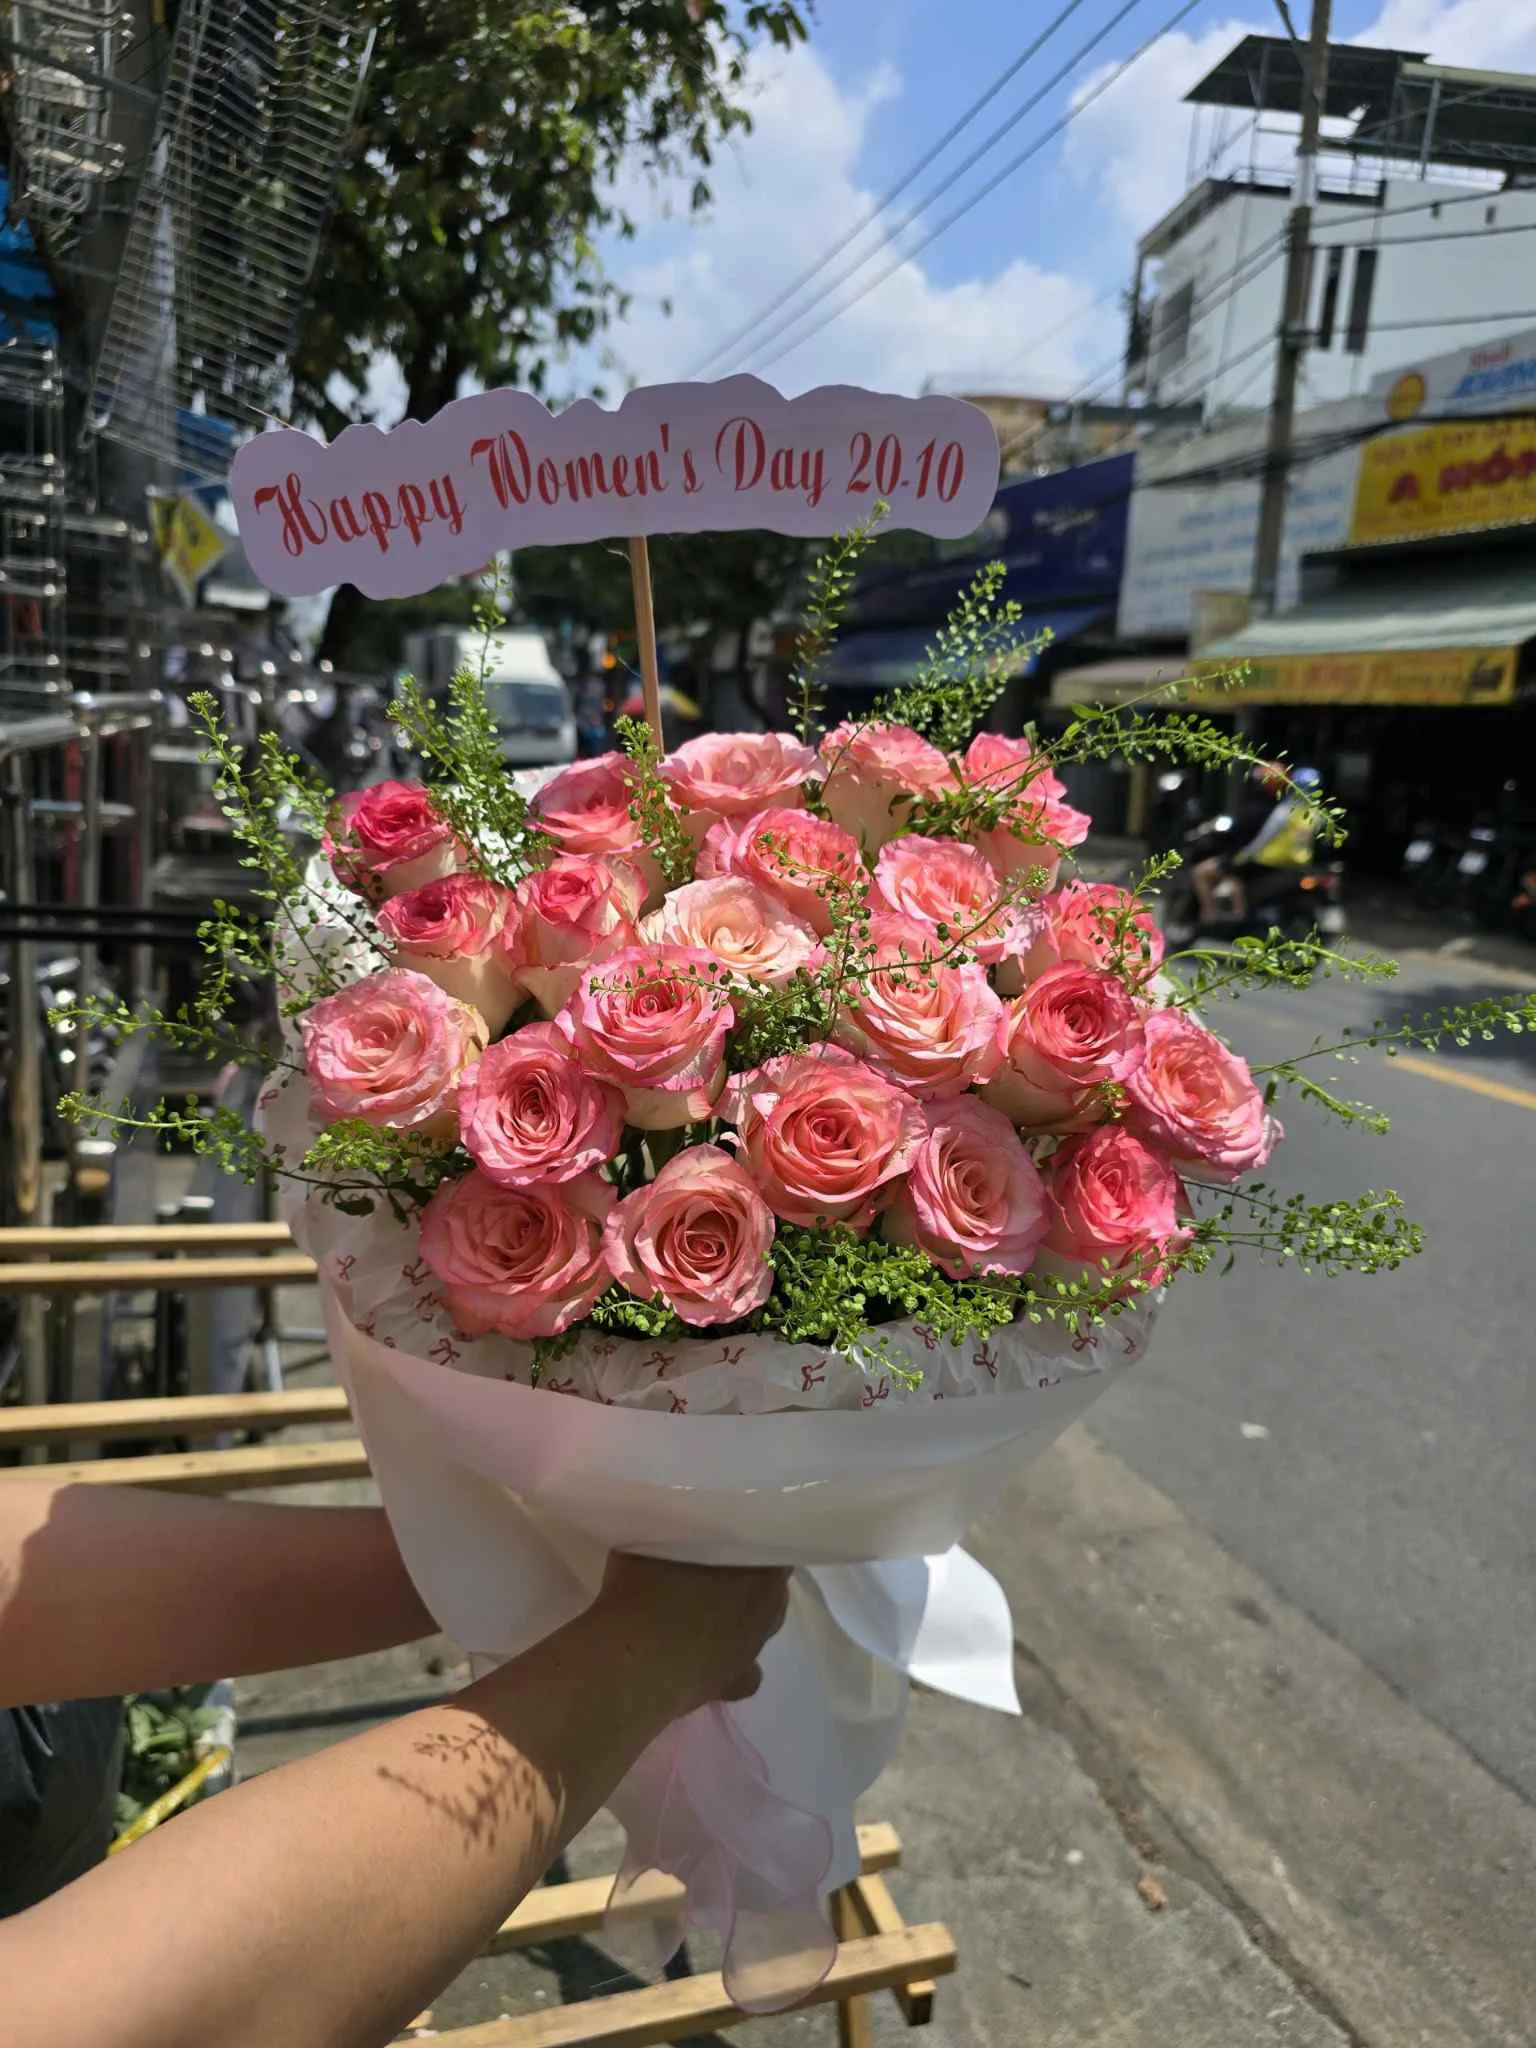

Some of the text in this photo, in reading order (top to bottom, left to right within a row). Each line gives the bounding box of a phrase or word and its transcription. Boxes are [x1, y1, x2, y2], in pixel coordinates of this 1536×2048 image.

[254, 472, 467, 557] Happy
[470, 422, 704, 510] Women's
[715, 416, 832, 508] Day
